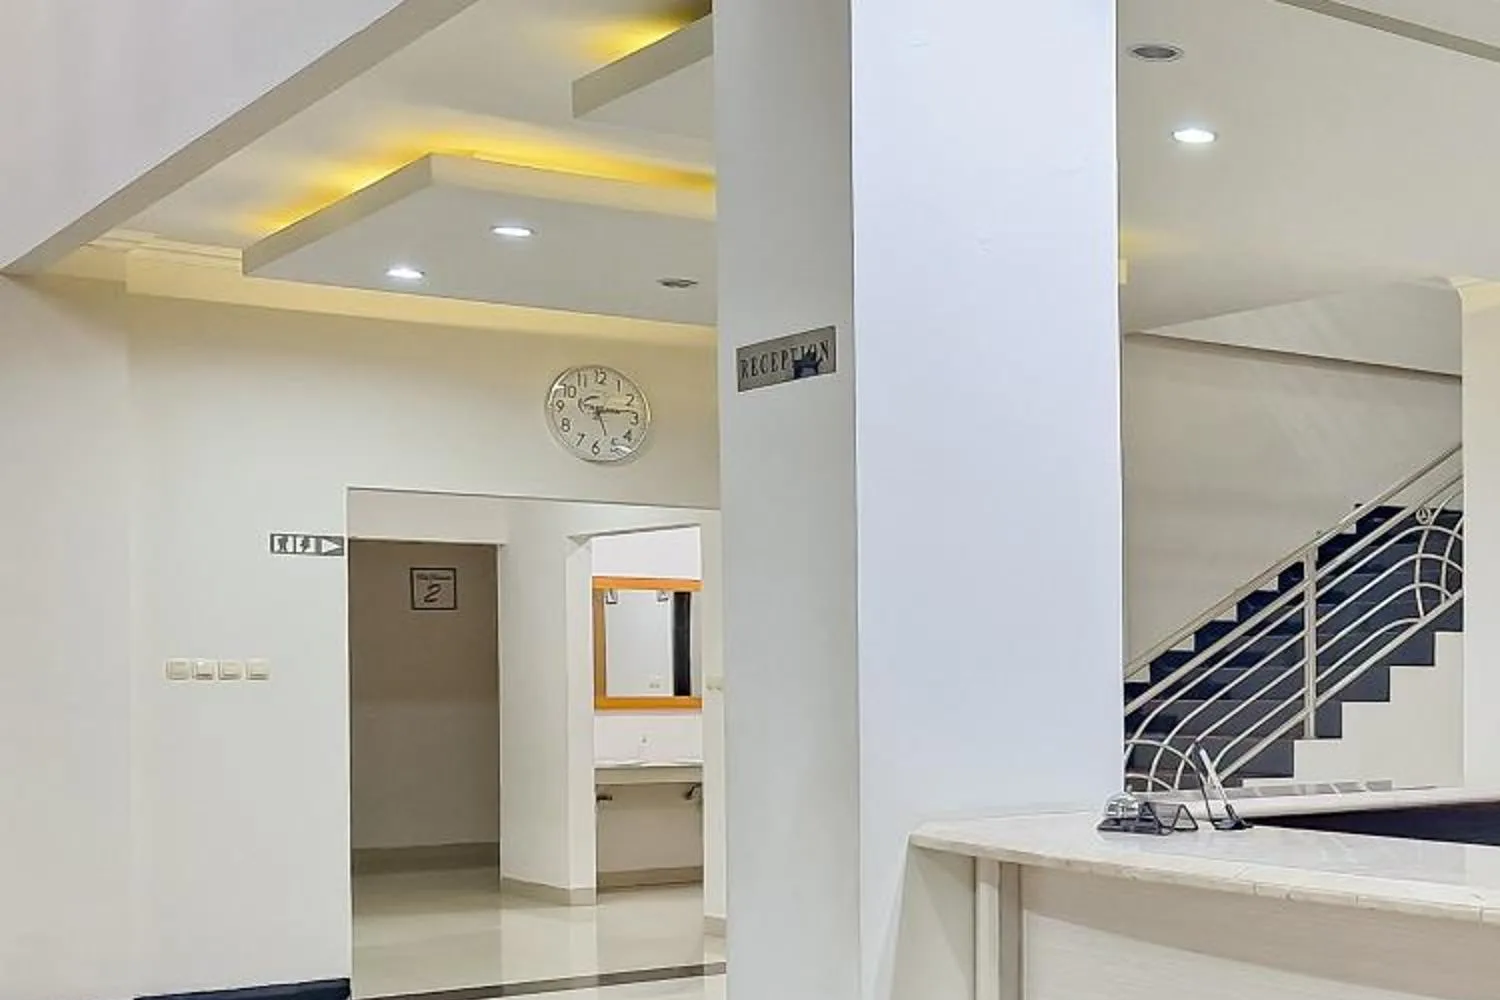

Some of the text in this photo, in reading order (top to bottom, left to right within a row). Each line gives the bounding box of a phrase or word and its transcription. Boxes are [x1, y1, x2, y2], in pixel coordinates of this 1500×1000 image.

[577, 370, 588, 388] 11
[594, 369, 607, 385] 12
[560, 384, 577, 399] 10
[616, 379, 621, 393] 1
[556, 399, 565, 412] 9
[625, 394, 634, 407] 2
[561, 417, 571, 432] 8
[630, 411, 639, 425] 3
[576, 433, 586, 446] 7
[622, 429, 632, 442] 4
[592, 440, 600, 455] 6
